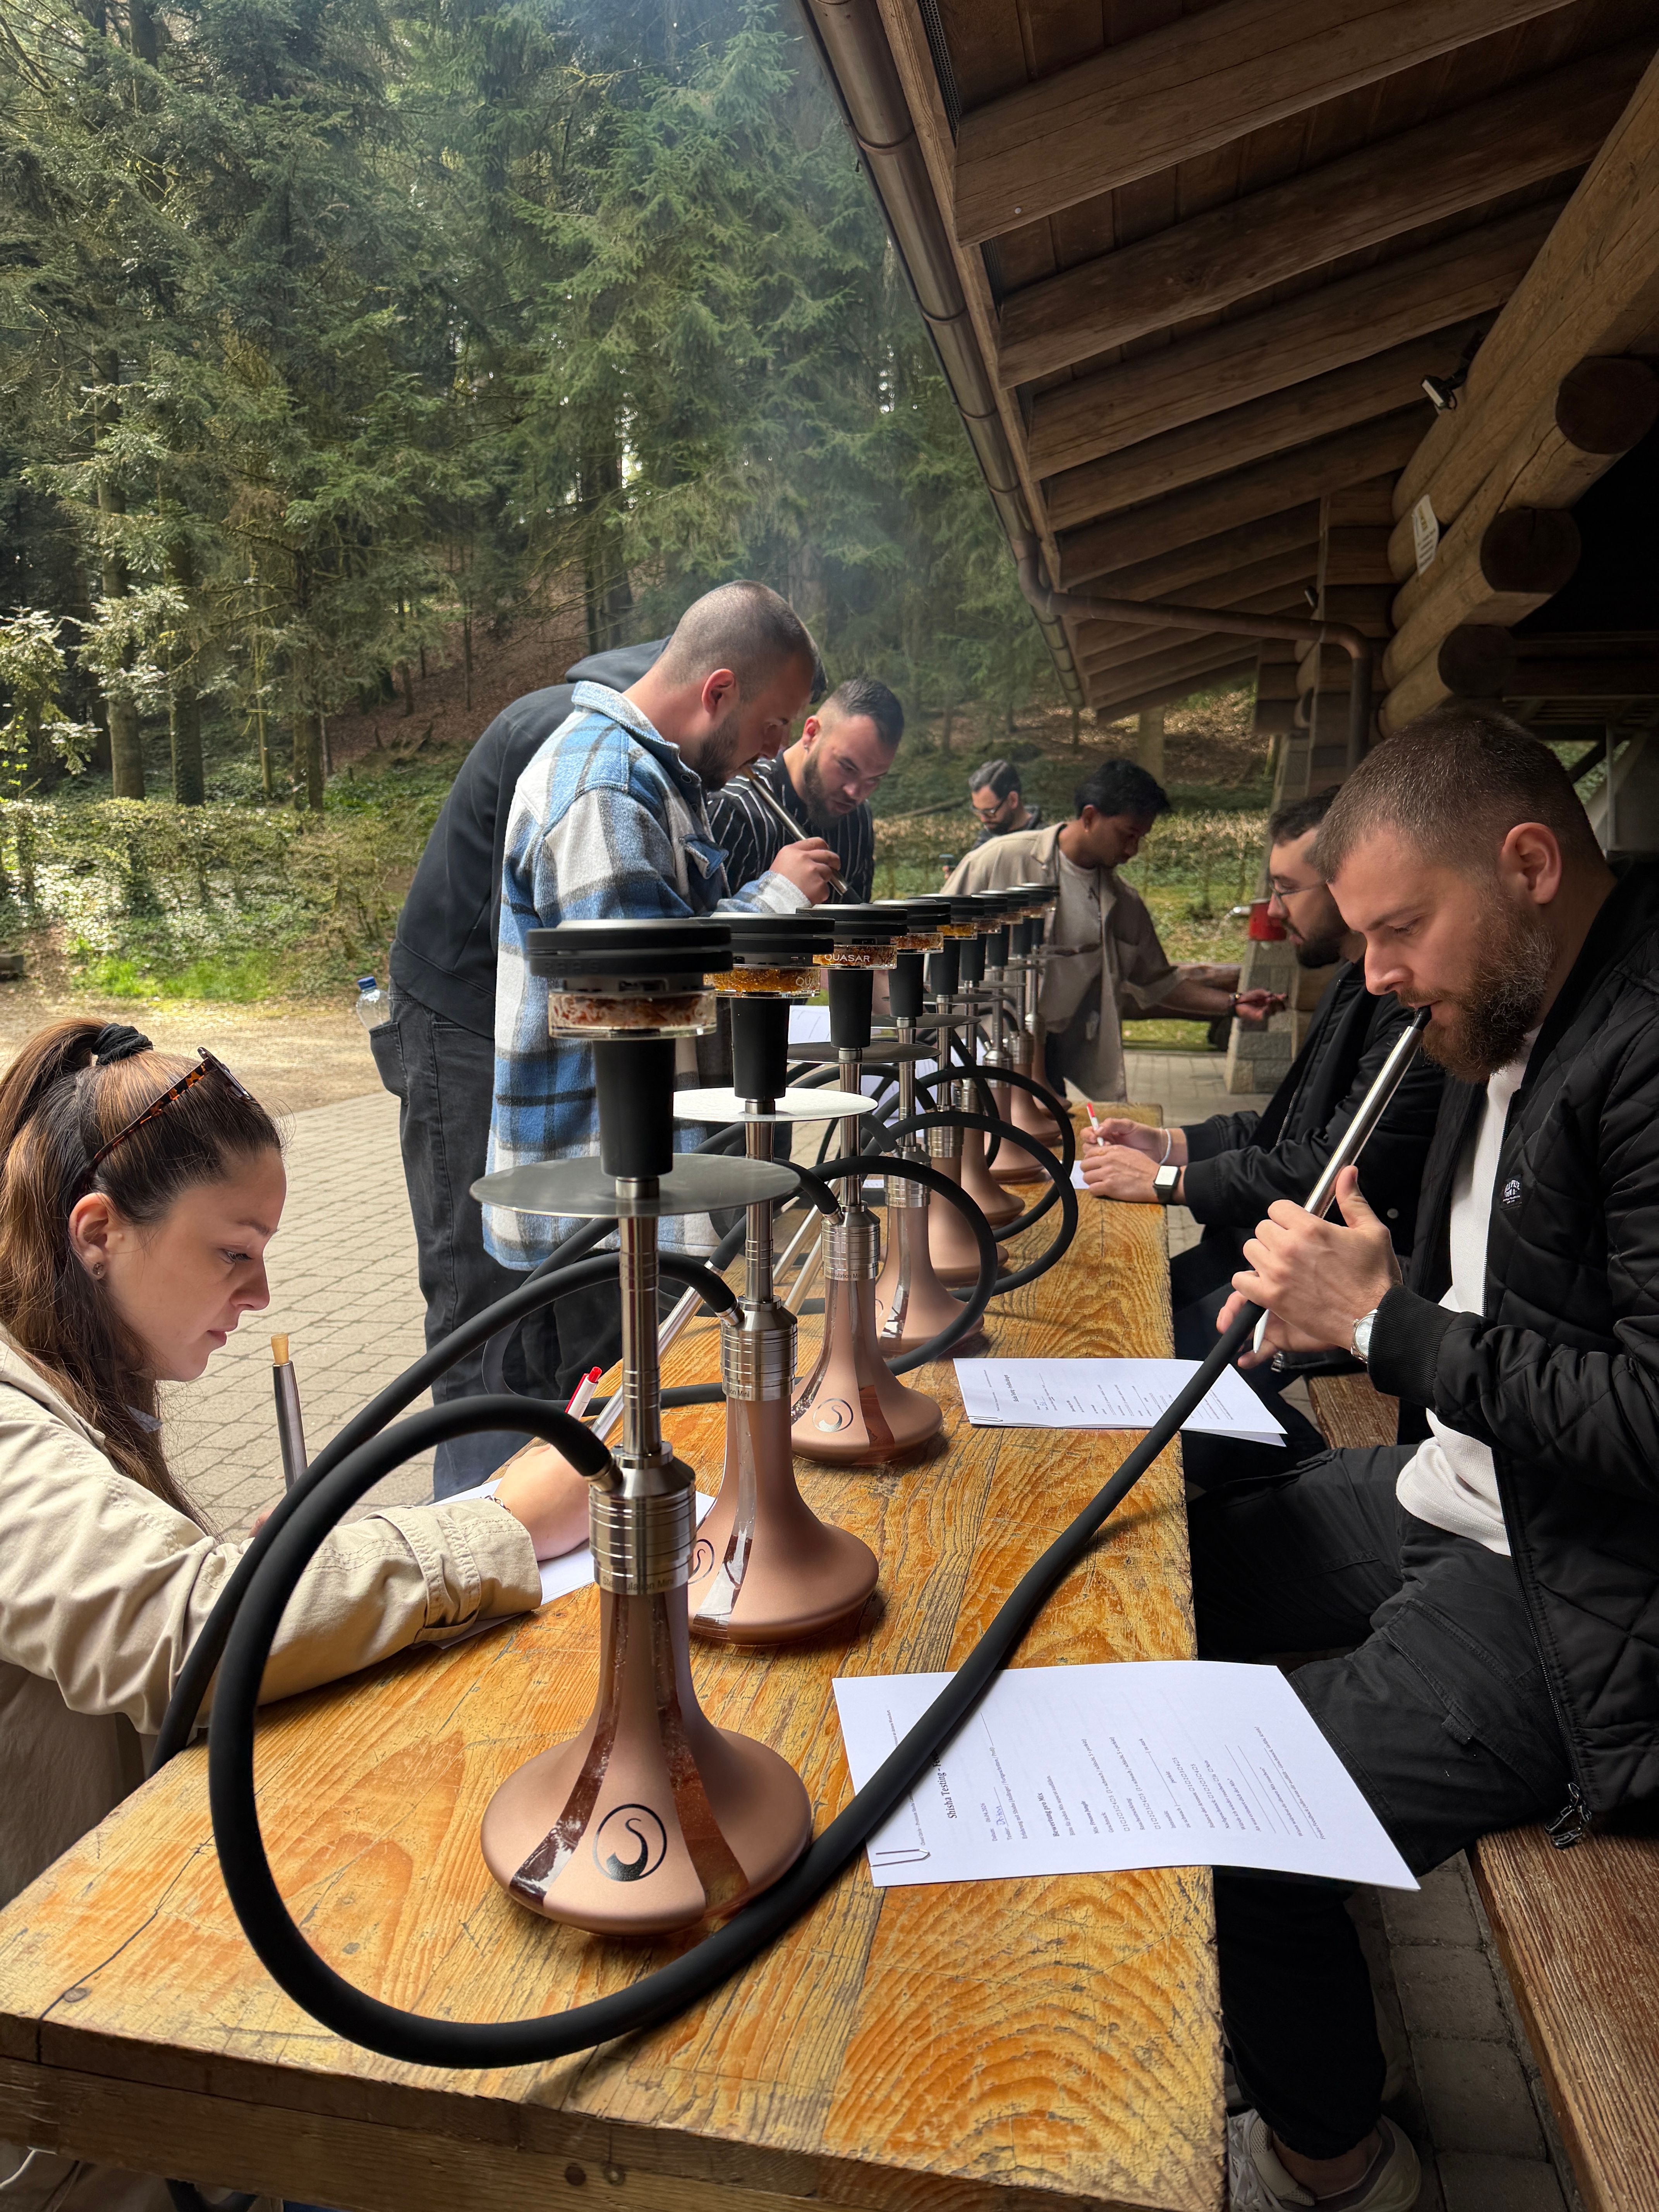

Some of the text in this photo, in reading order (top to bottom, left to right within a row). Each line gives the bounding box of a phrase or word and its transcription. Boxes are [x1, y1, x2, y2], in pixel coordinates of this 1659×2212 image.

[824, 954, 870, 962] QUASAR
[603, 1576, 654, 1590] Steulaon
[938, 1772, 950, 1796] Testing
[944, 1797, 957, 1819] Shisha
[1041, 1802, 1051, 1810] pro
[1045, 1810, 1060, 1836] Bewertung
